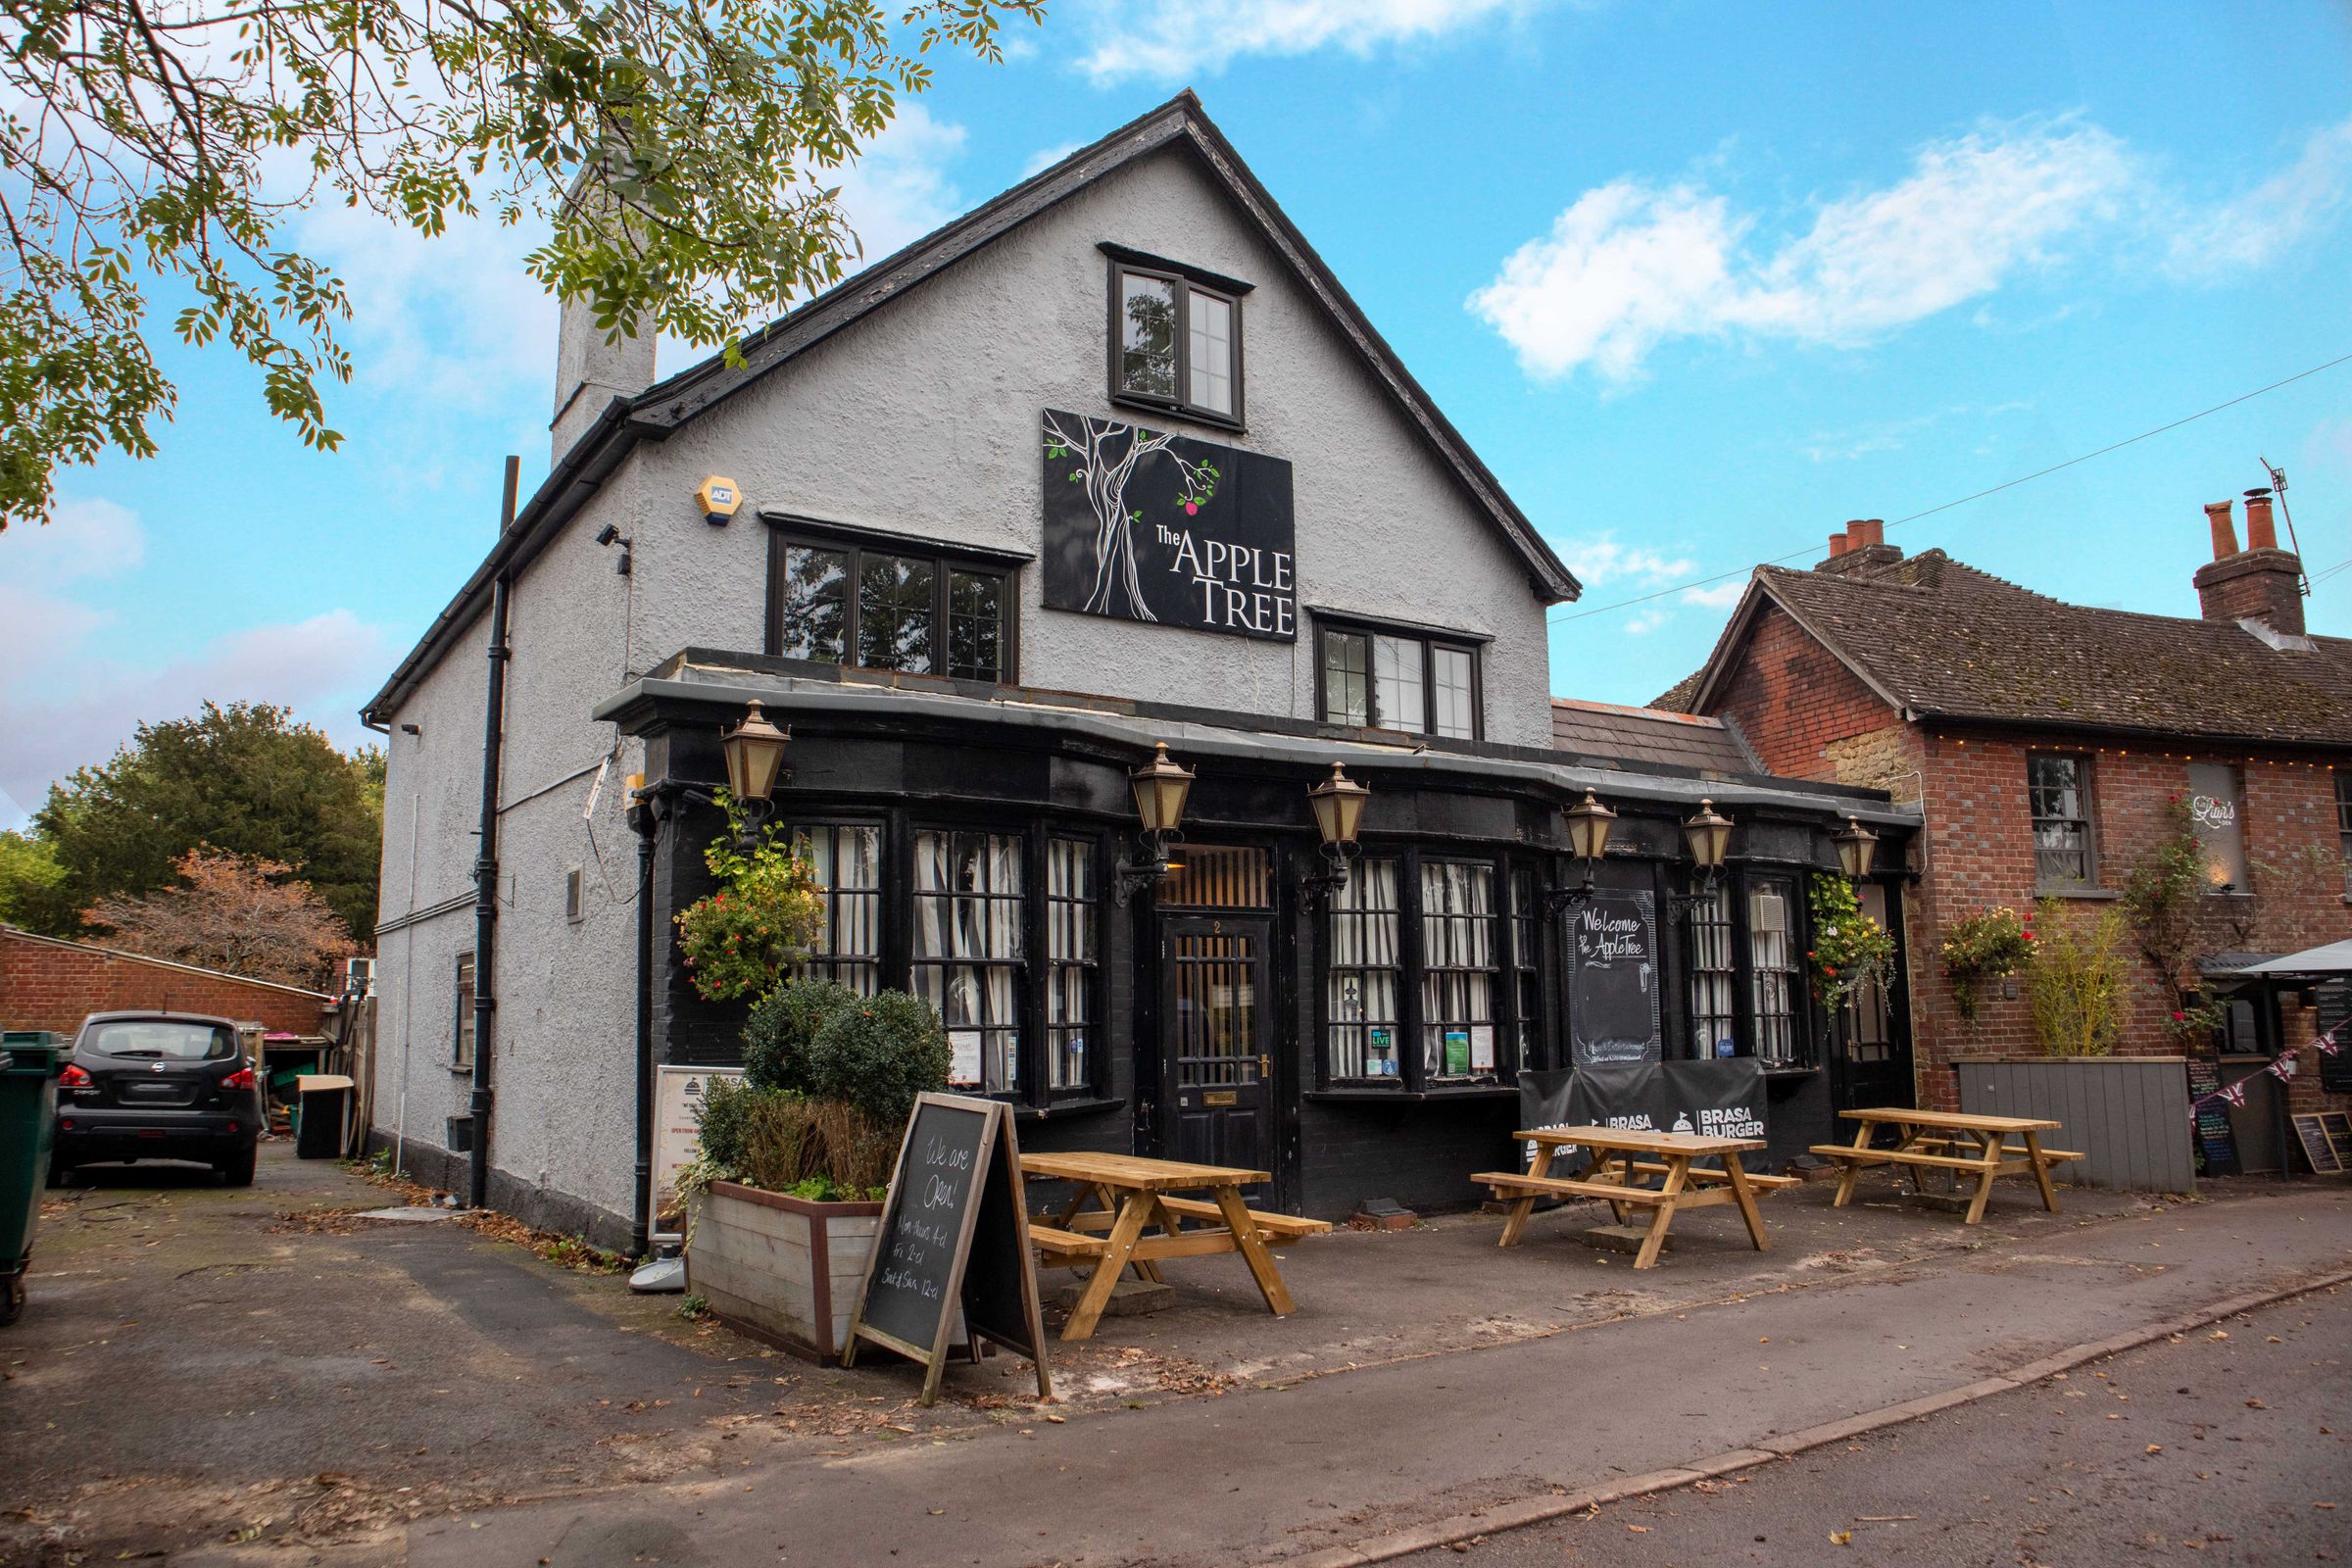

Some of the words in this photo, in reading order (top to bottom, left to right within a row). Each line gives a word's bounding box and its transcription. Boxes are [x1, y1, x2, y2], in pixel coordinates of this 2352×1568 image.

[711, 489, 733, 501] ADT
[1156, 523, 1180, 546] The
[1169, 529, 1293, 591] APPLE
[1192, 576, 1294, 635] TREE
[1214, 920, 1221, 934] 2
[1581, 907, 1642, 932] Welcome
[1579, 934, 1588, 943] to
[1372, 1036, 1390, 1045] LIVE
[1609, 1113, 1653, 1130] BRASA
[1700, 1106, 1752, 1124] BRASA
[1702, 1120, 1764, 1138] BURGER
[926, 1134, 947, 1165] We
[949, 1149, 968, 1170] are
